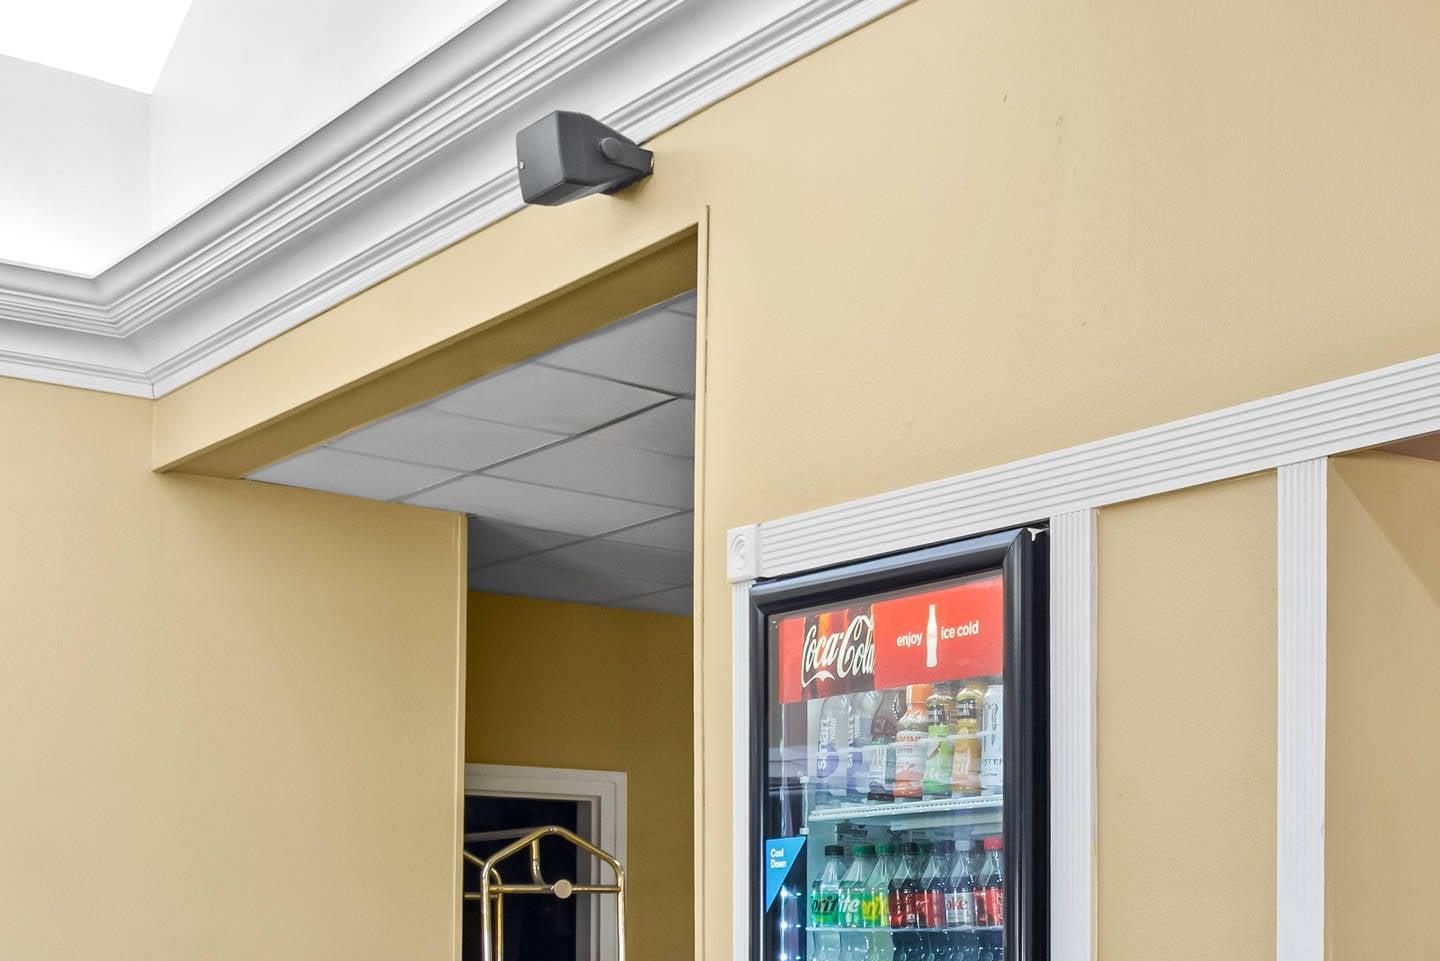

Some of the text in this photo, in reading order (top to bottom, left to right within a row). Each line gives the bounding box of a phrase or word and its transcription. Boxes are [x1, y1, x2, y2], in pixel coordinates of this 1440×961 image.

[802, 614, 876, 688] Coca-Cola
[896, 620, 980, 648] enjoy ice cold
[818, 717, 831, 770] smart
